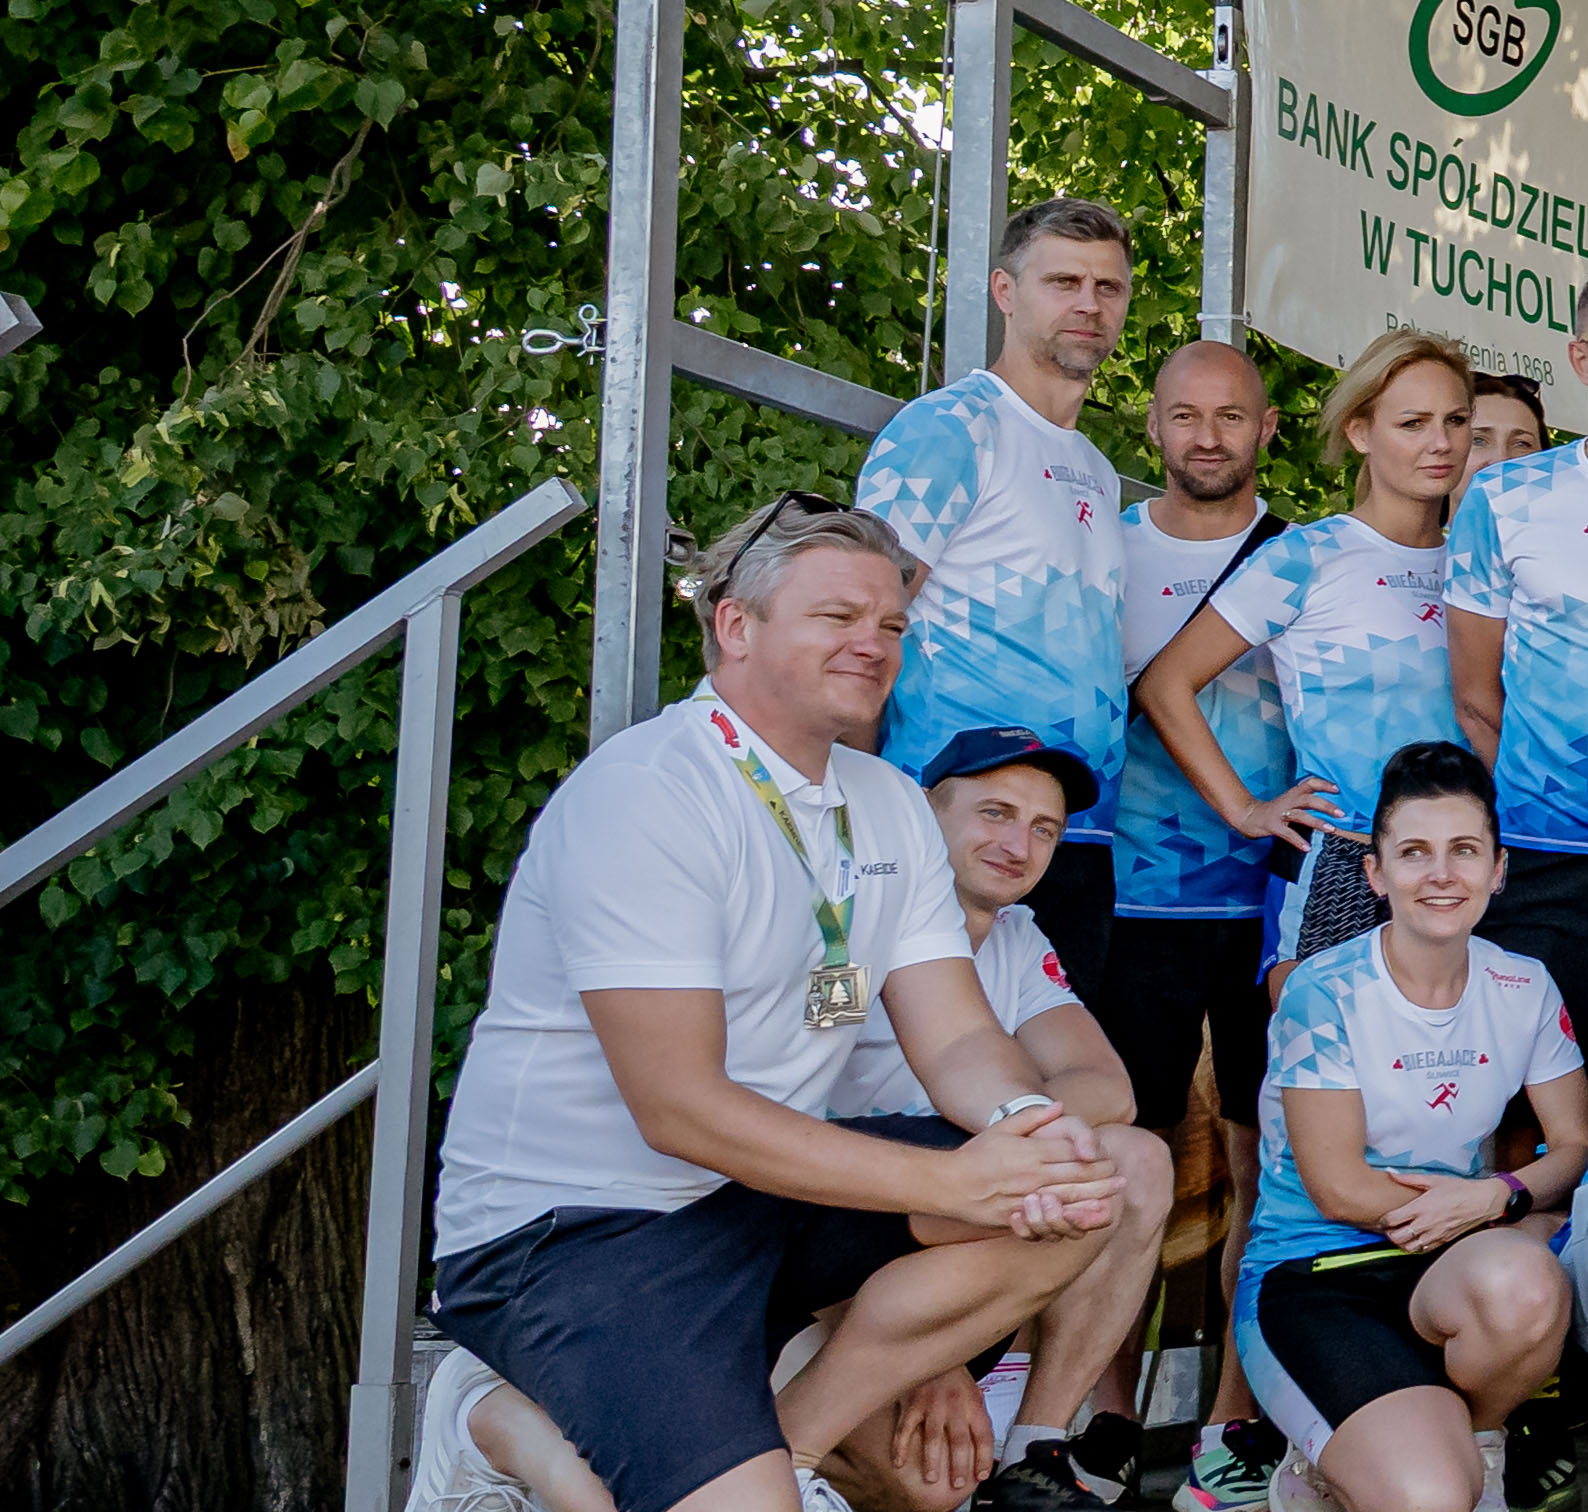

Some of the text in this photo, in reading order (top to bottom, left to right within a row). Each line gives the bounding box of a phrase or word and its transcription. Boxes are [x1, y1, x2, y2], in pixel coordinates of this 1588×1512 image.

[1278, 76, 1377, 179] BANK
[1359, 209, 1395, 276] W
[1513, 351, 1554, 386] 1868
